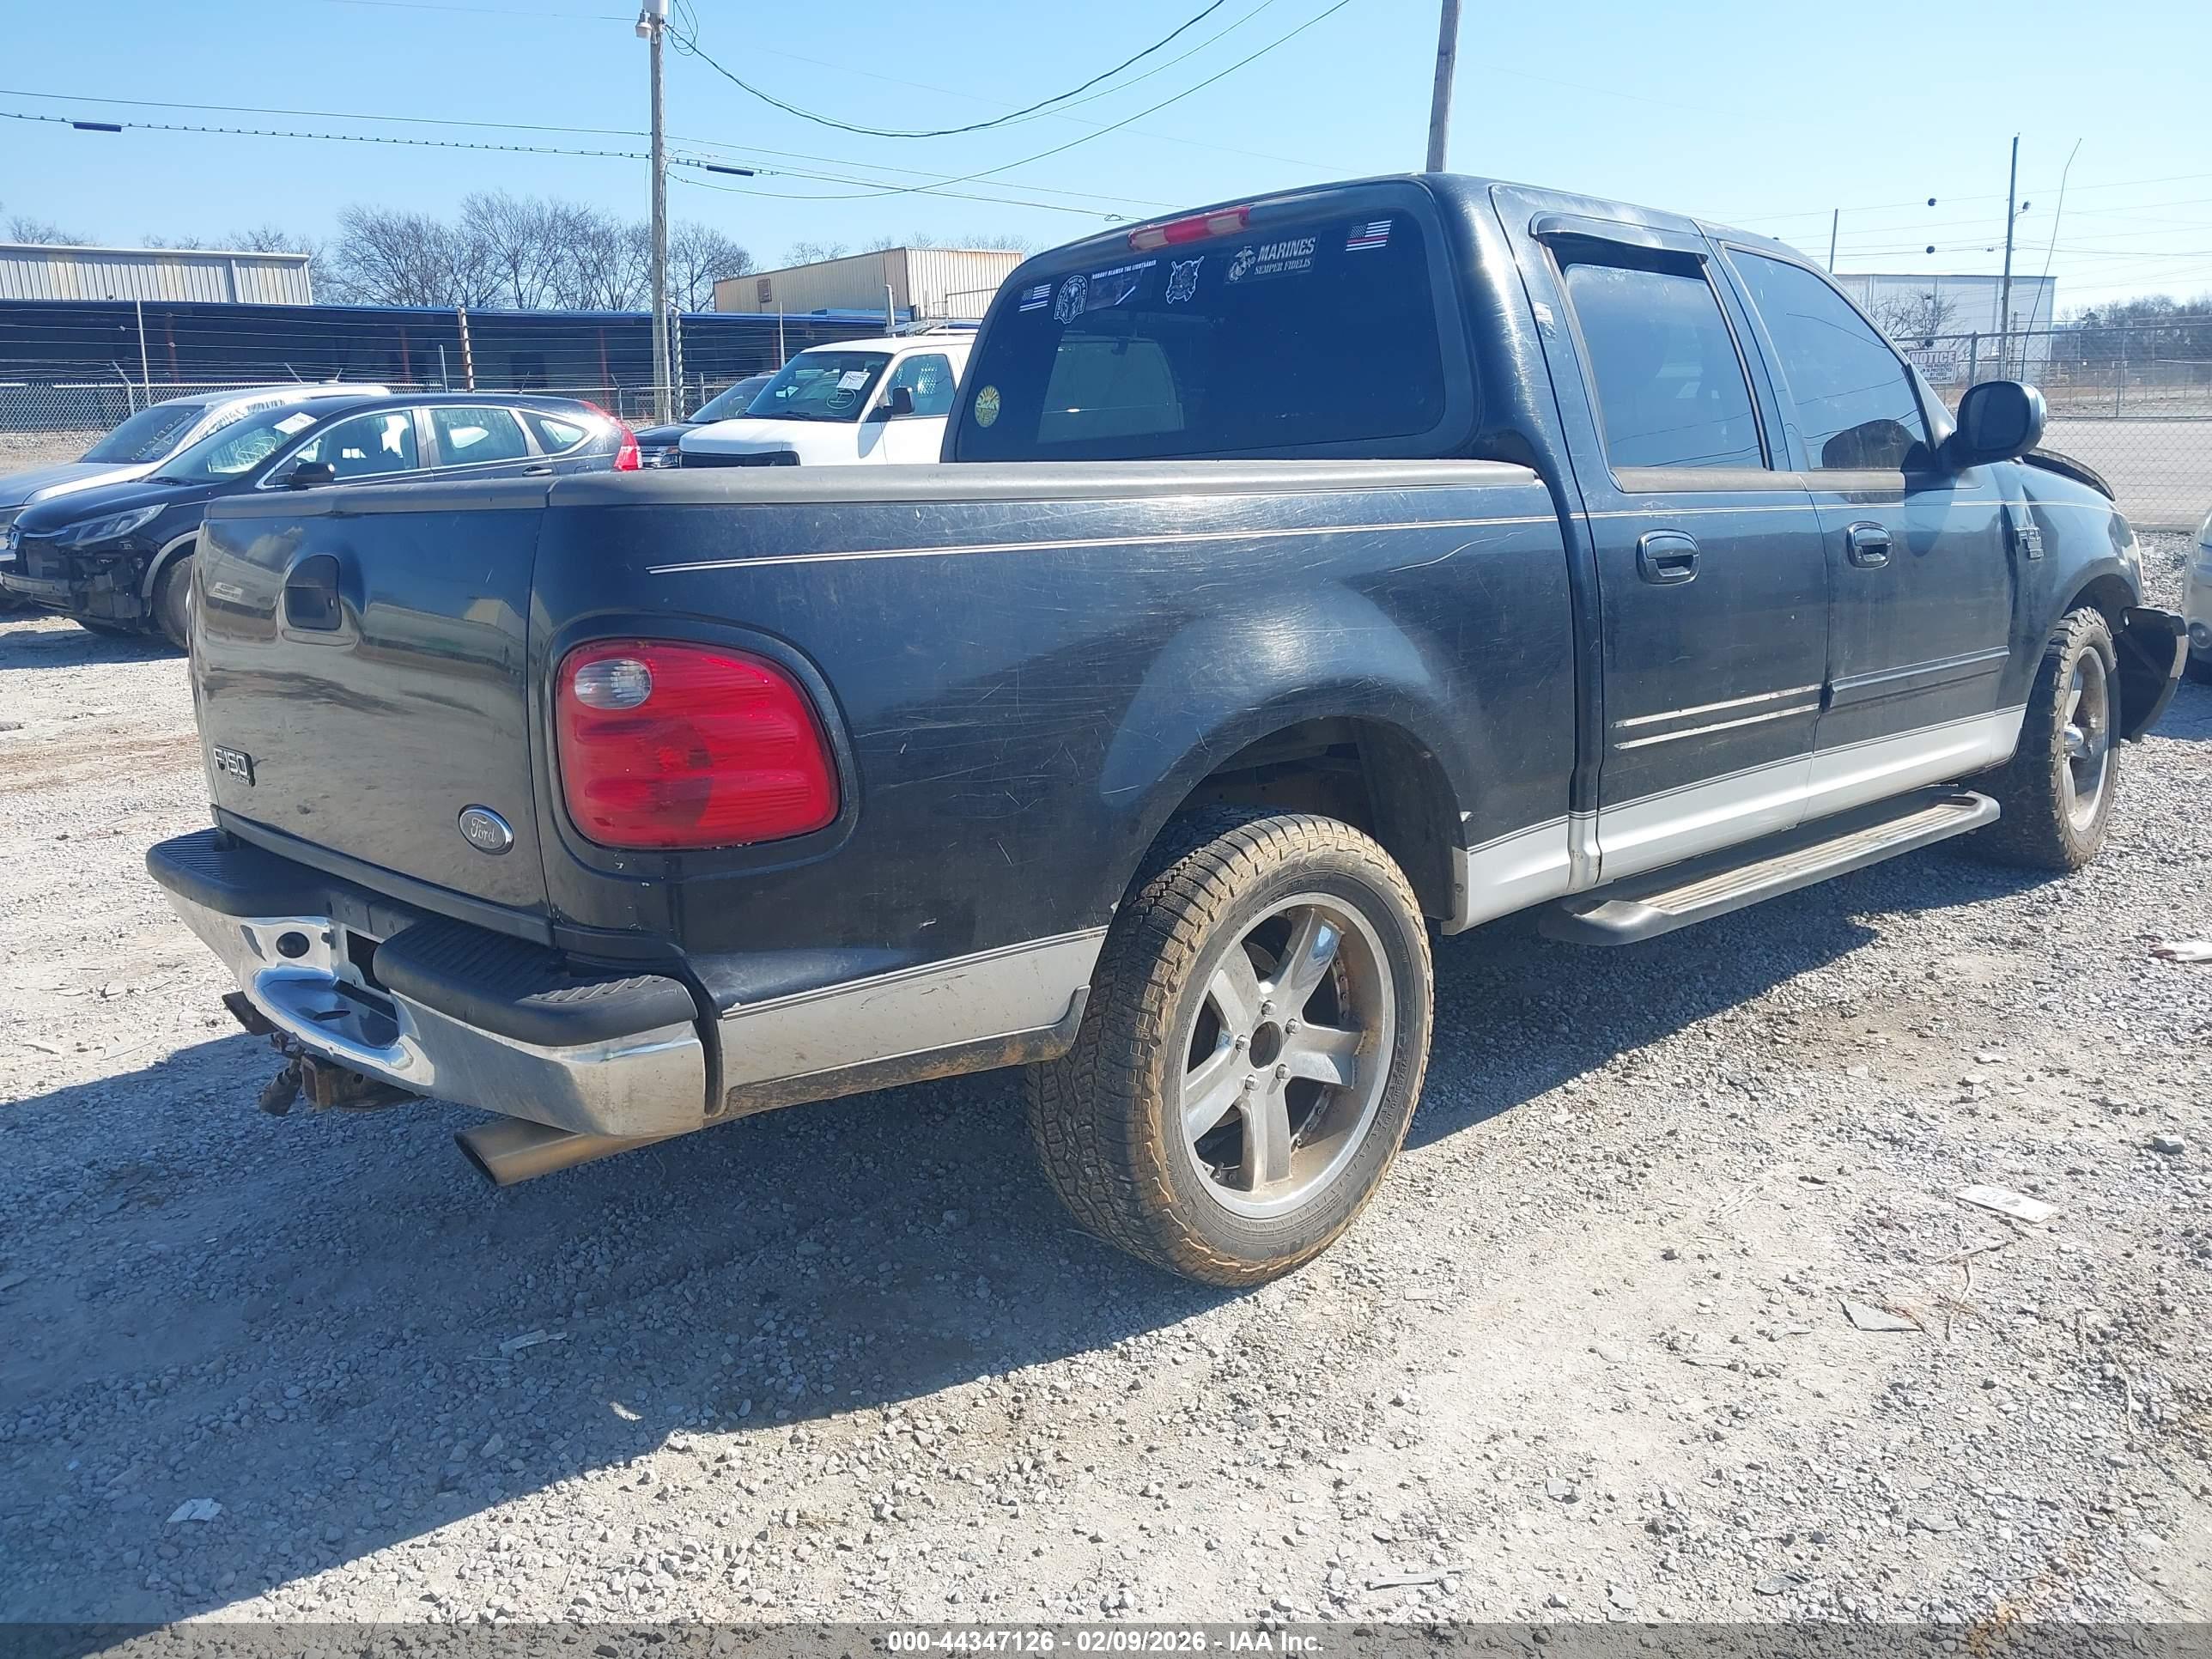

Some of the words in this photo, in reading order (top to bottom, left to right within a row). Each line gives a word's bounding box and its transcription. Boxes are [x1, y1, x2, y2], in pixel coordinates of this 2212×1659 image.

[1257, 237, 1316, 262] MARINES
[1254, 261, 1283, 275] SEMPER
[1283, 258, 1311, 271] FIDELIS
[1910, 352, 1955, 363] NOTICE
[471, 817, 495, 842] Ford
